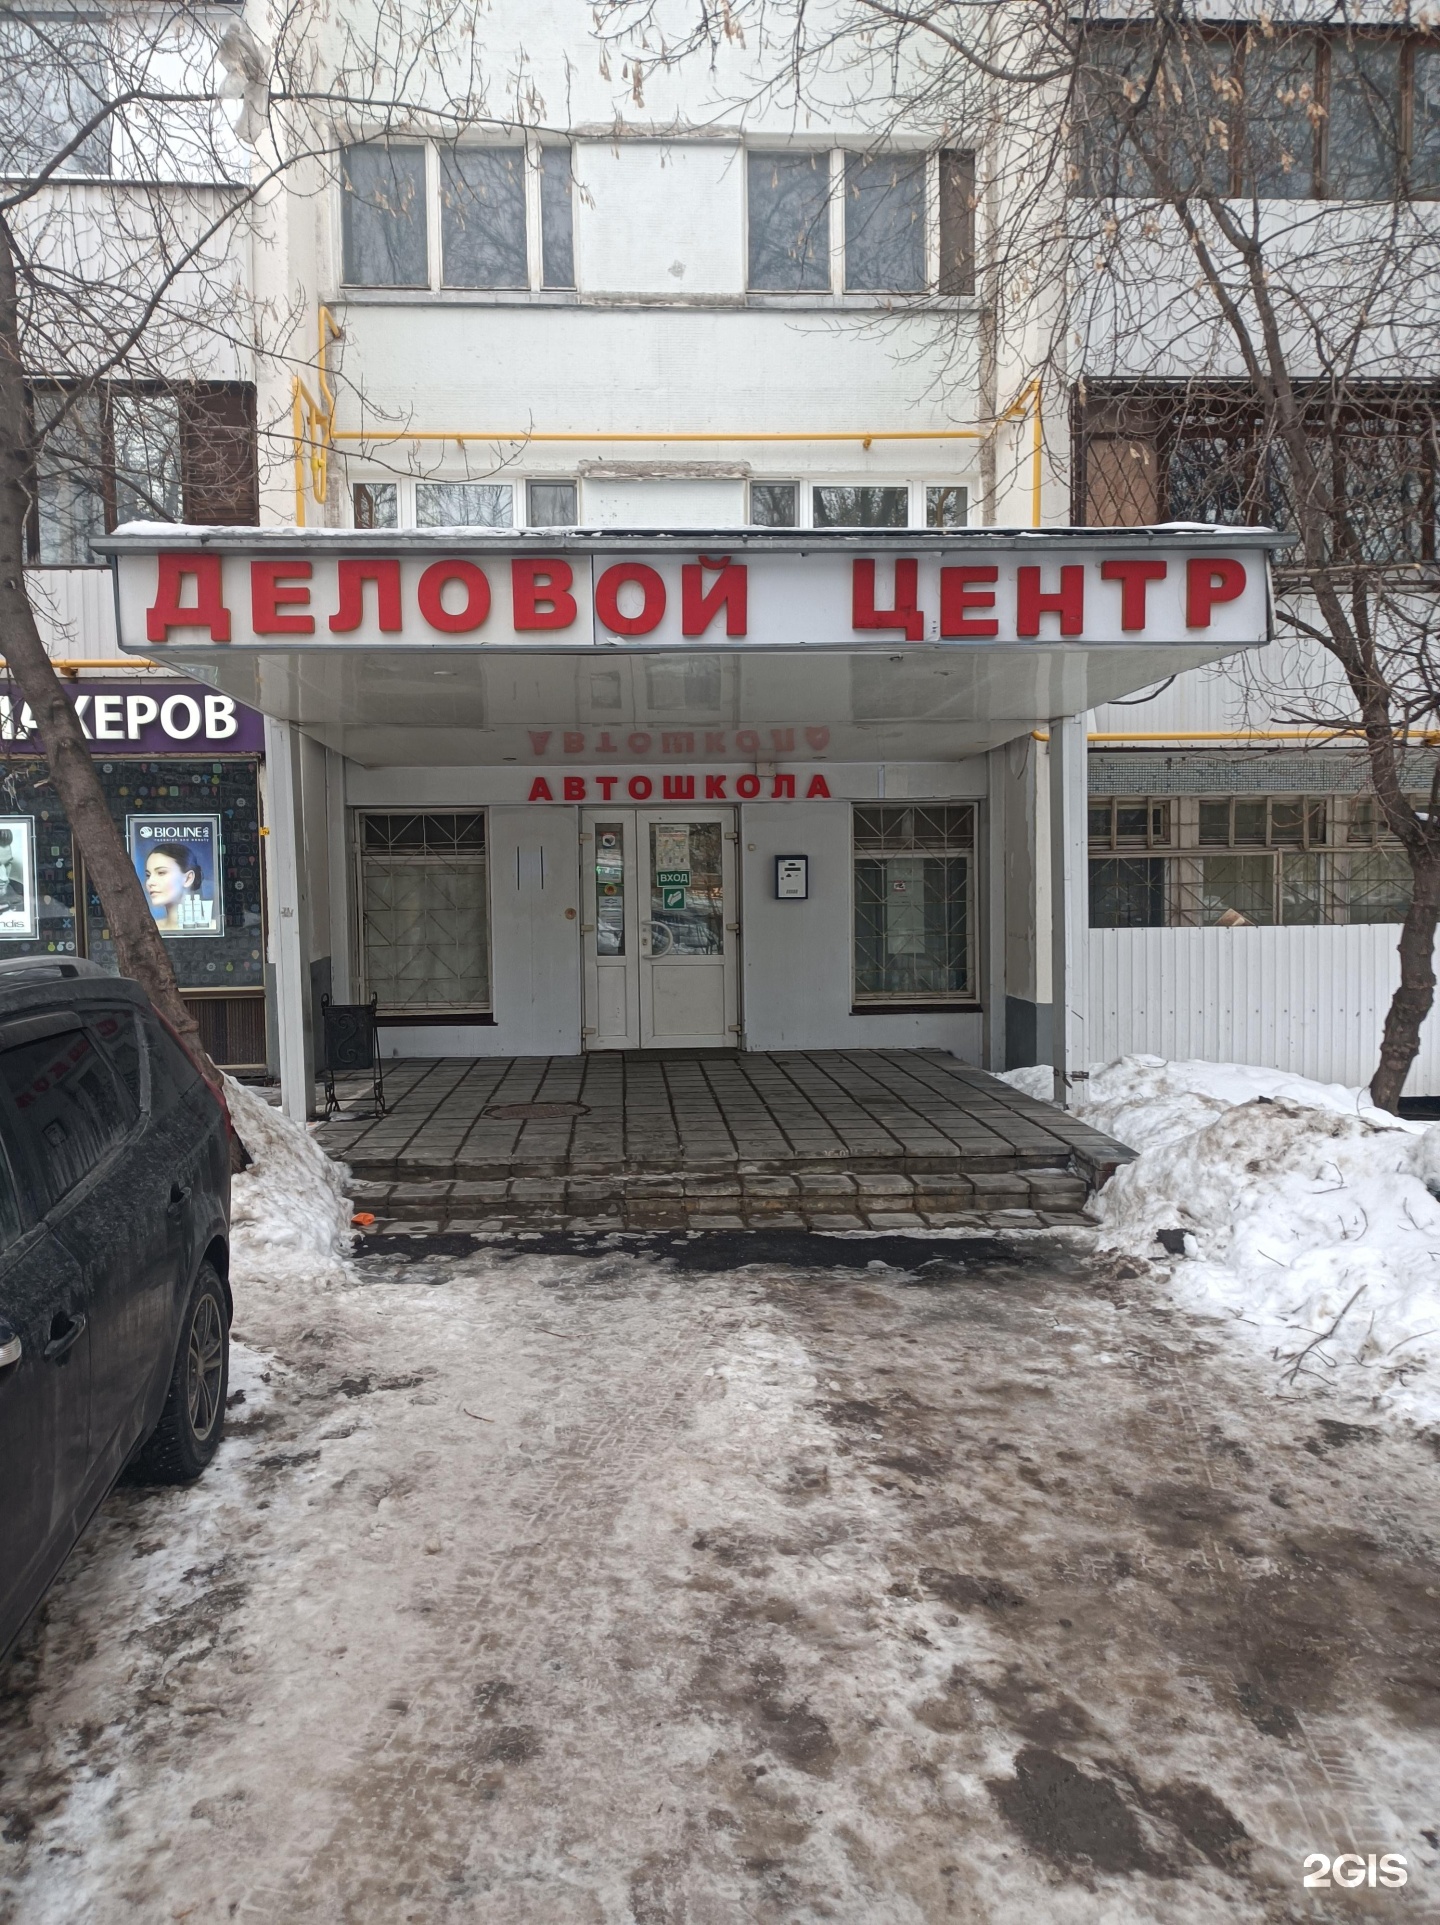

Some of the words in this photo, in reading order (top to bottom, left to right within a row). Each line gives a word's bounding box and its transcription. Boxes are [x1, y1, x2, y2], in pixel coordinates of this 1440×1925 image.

[147, 553, 747, 642] ДЕЛОВОЙ
[852, 557, 1247, 641] ЦЕНТР
[527, 774, 831, 801] АВТОШКОЛА
[154, 826, 202, 837] BIOLINE
[660, 873, 689, 884] ВХОД
